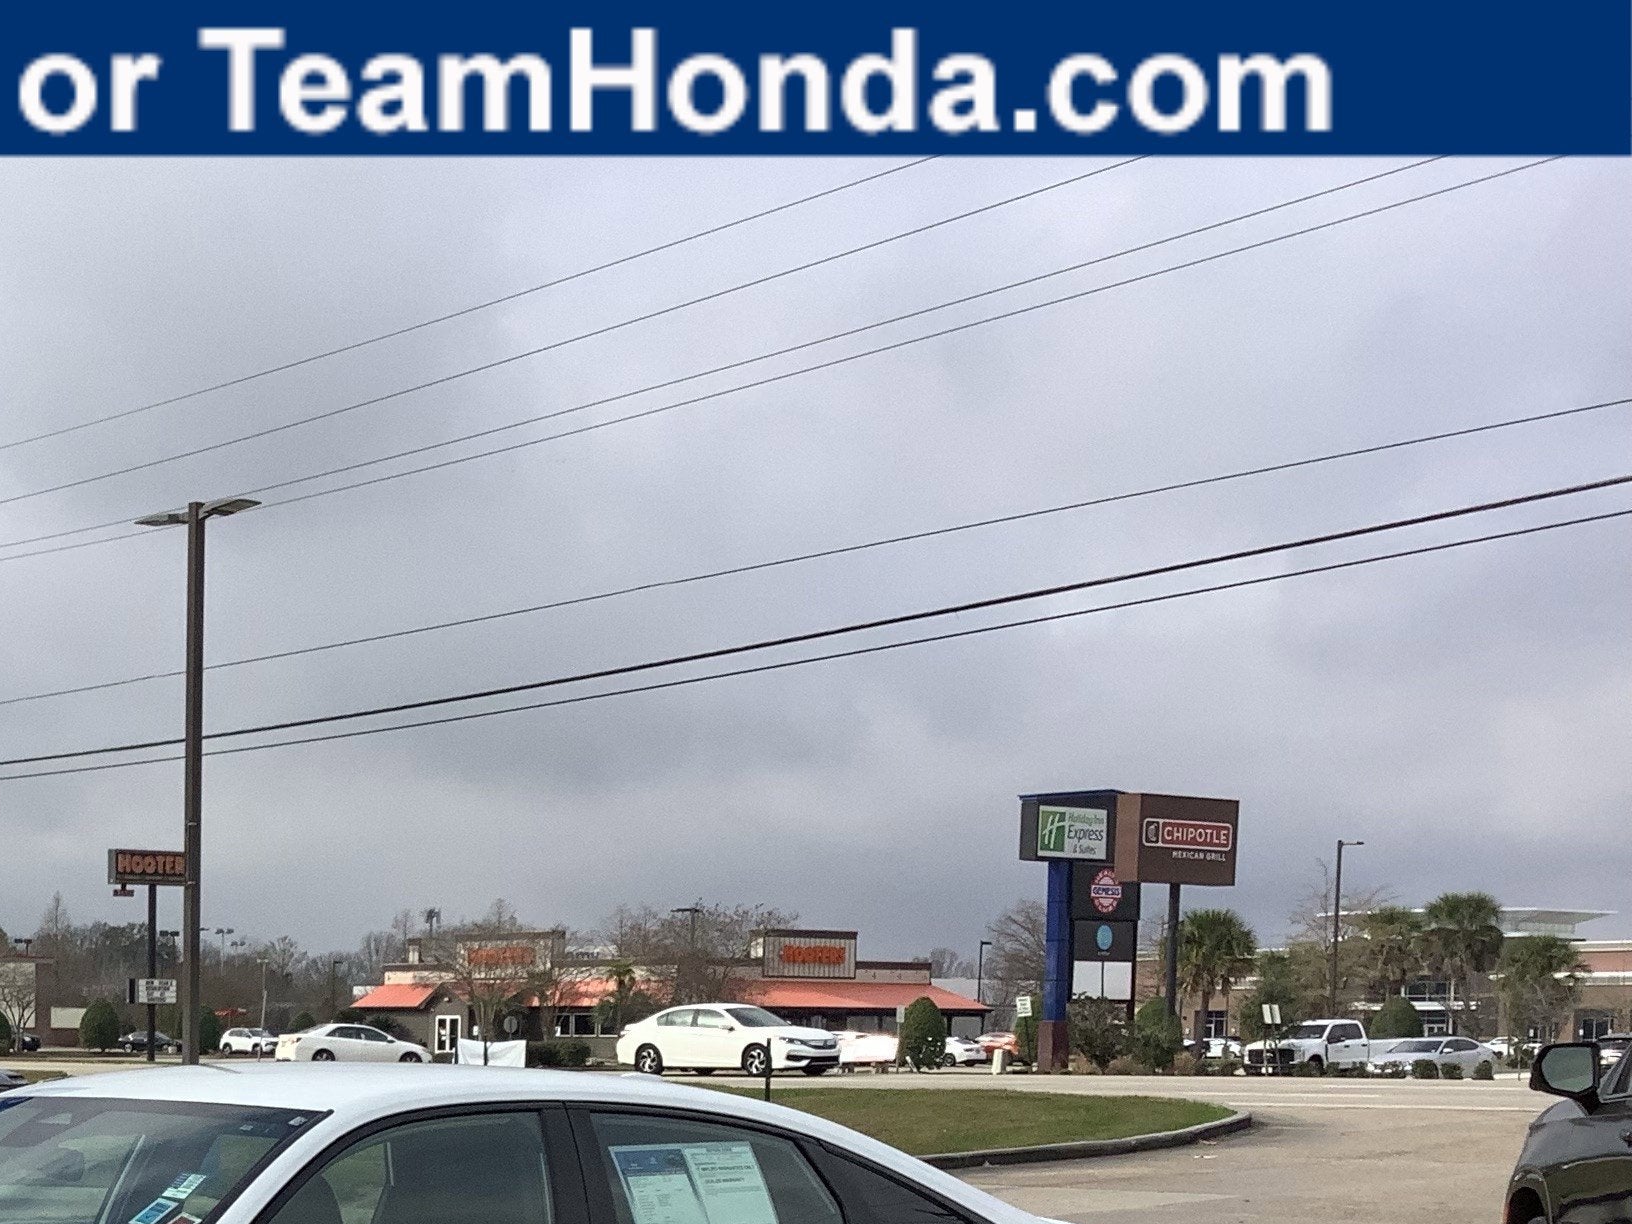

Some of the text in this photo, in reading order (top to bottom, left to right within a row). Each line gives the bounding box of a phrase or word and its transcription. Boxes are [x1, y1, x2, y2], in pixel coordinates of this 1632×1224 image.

[1067, 824, 1104, 843] Express
[1163, 826, 1228, 844] CHIPOTLE
[117, 853, 185, 875] HOOTER
[1172, 850, 1226, 862] MEXICAN GRILL
